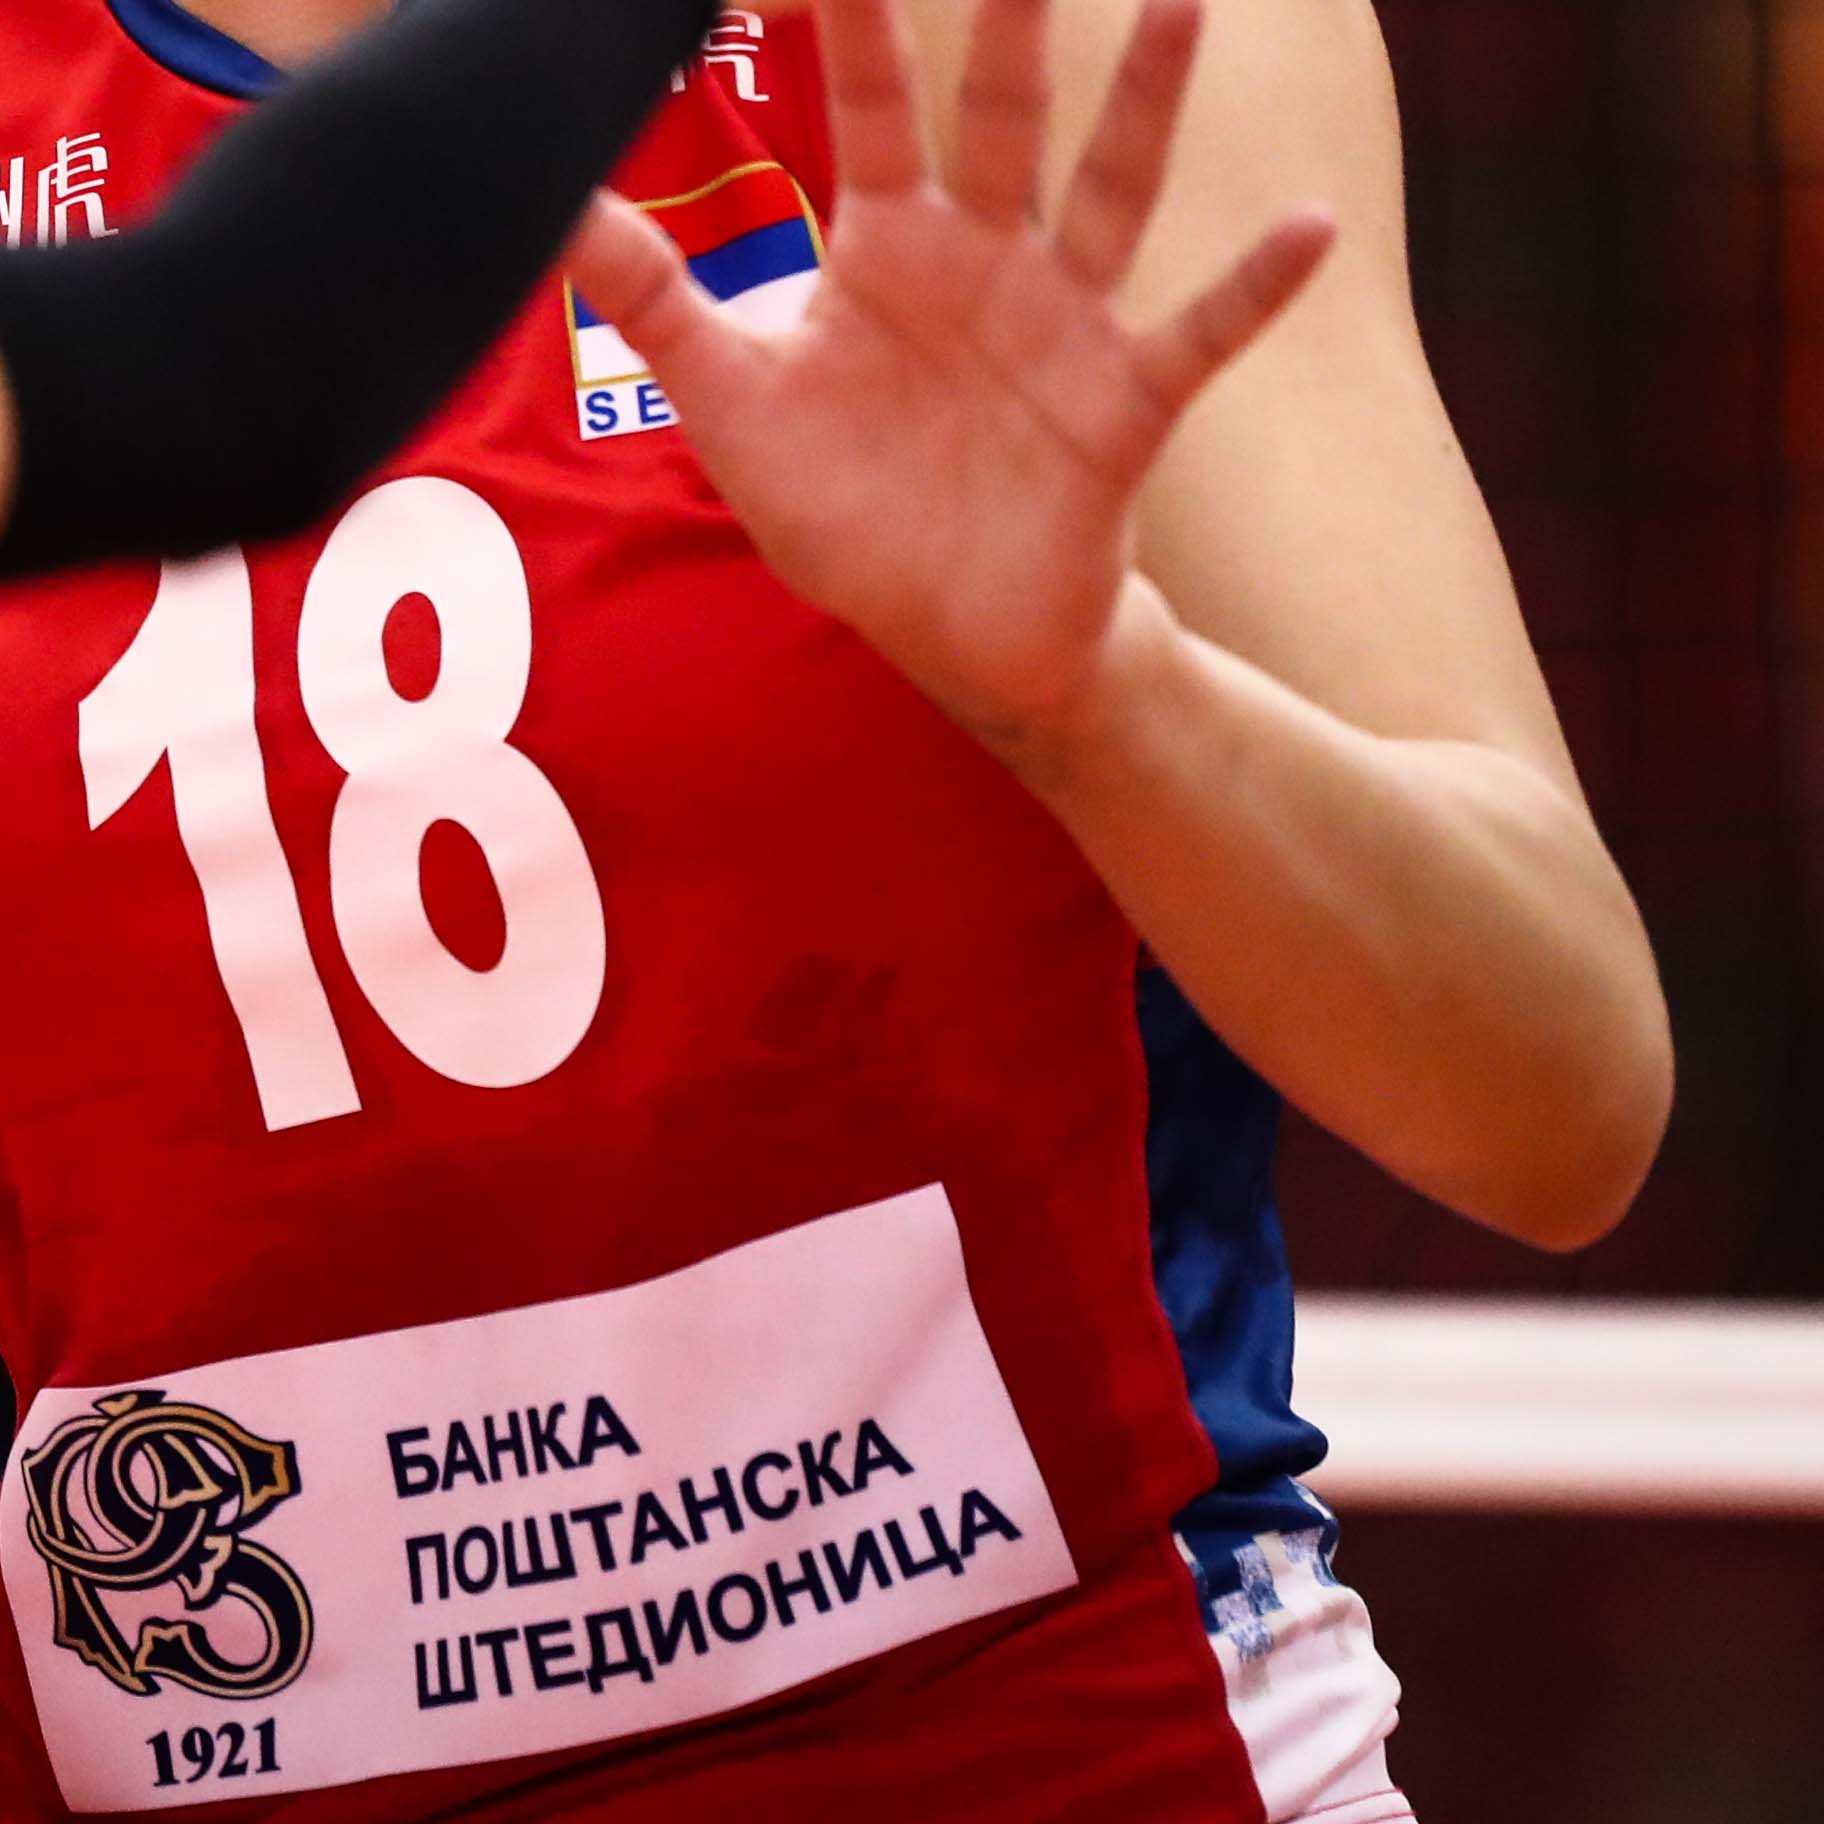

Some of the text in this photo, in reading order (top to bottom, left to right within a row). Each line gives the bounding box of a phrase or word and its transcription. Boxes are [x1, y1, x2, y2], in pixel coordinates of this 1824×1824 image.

[78, 475, 607, 1133] 18
[386, 1394, 642, 1499] БАНКА
[405, 1417, 915, 1605] ПОШТАНСКА
[413, 1488, 1024, 1711] ШТЕДИОНИЦА
[145, 1717, 282, 1788] 1921
